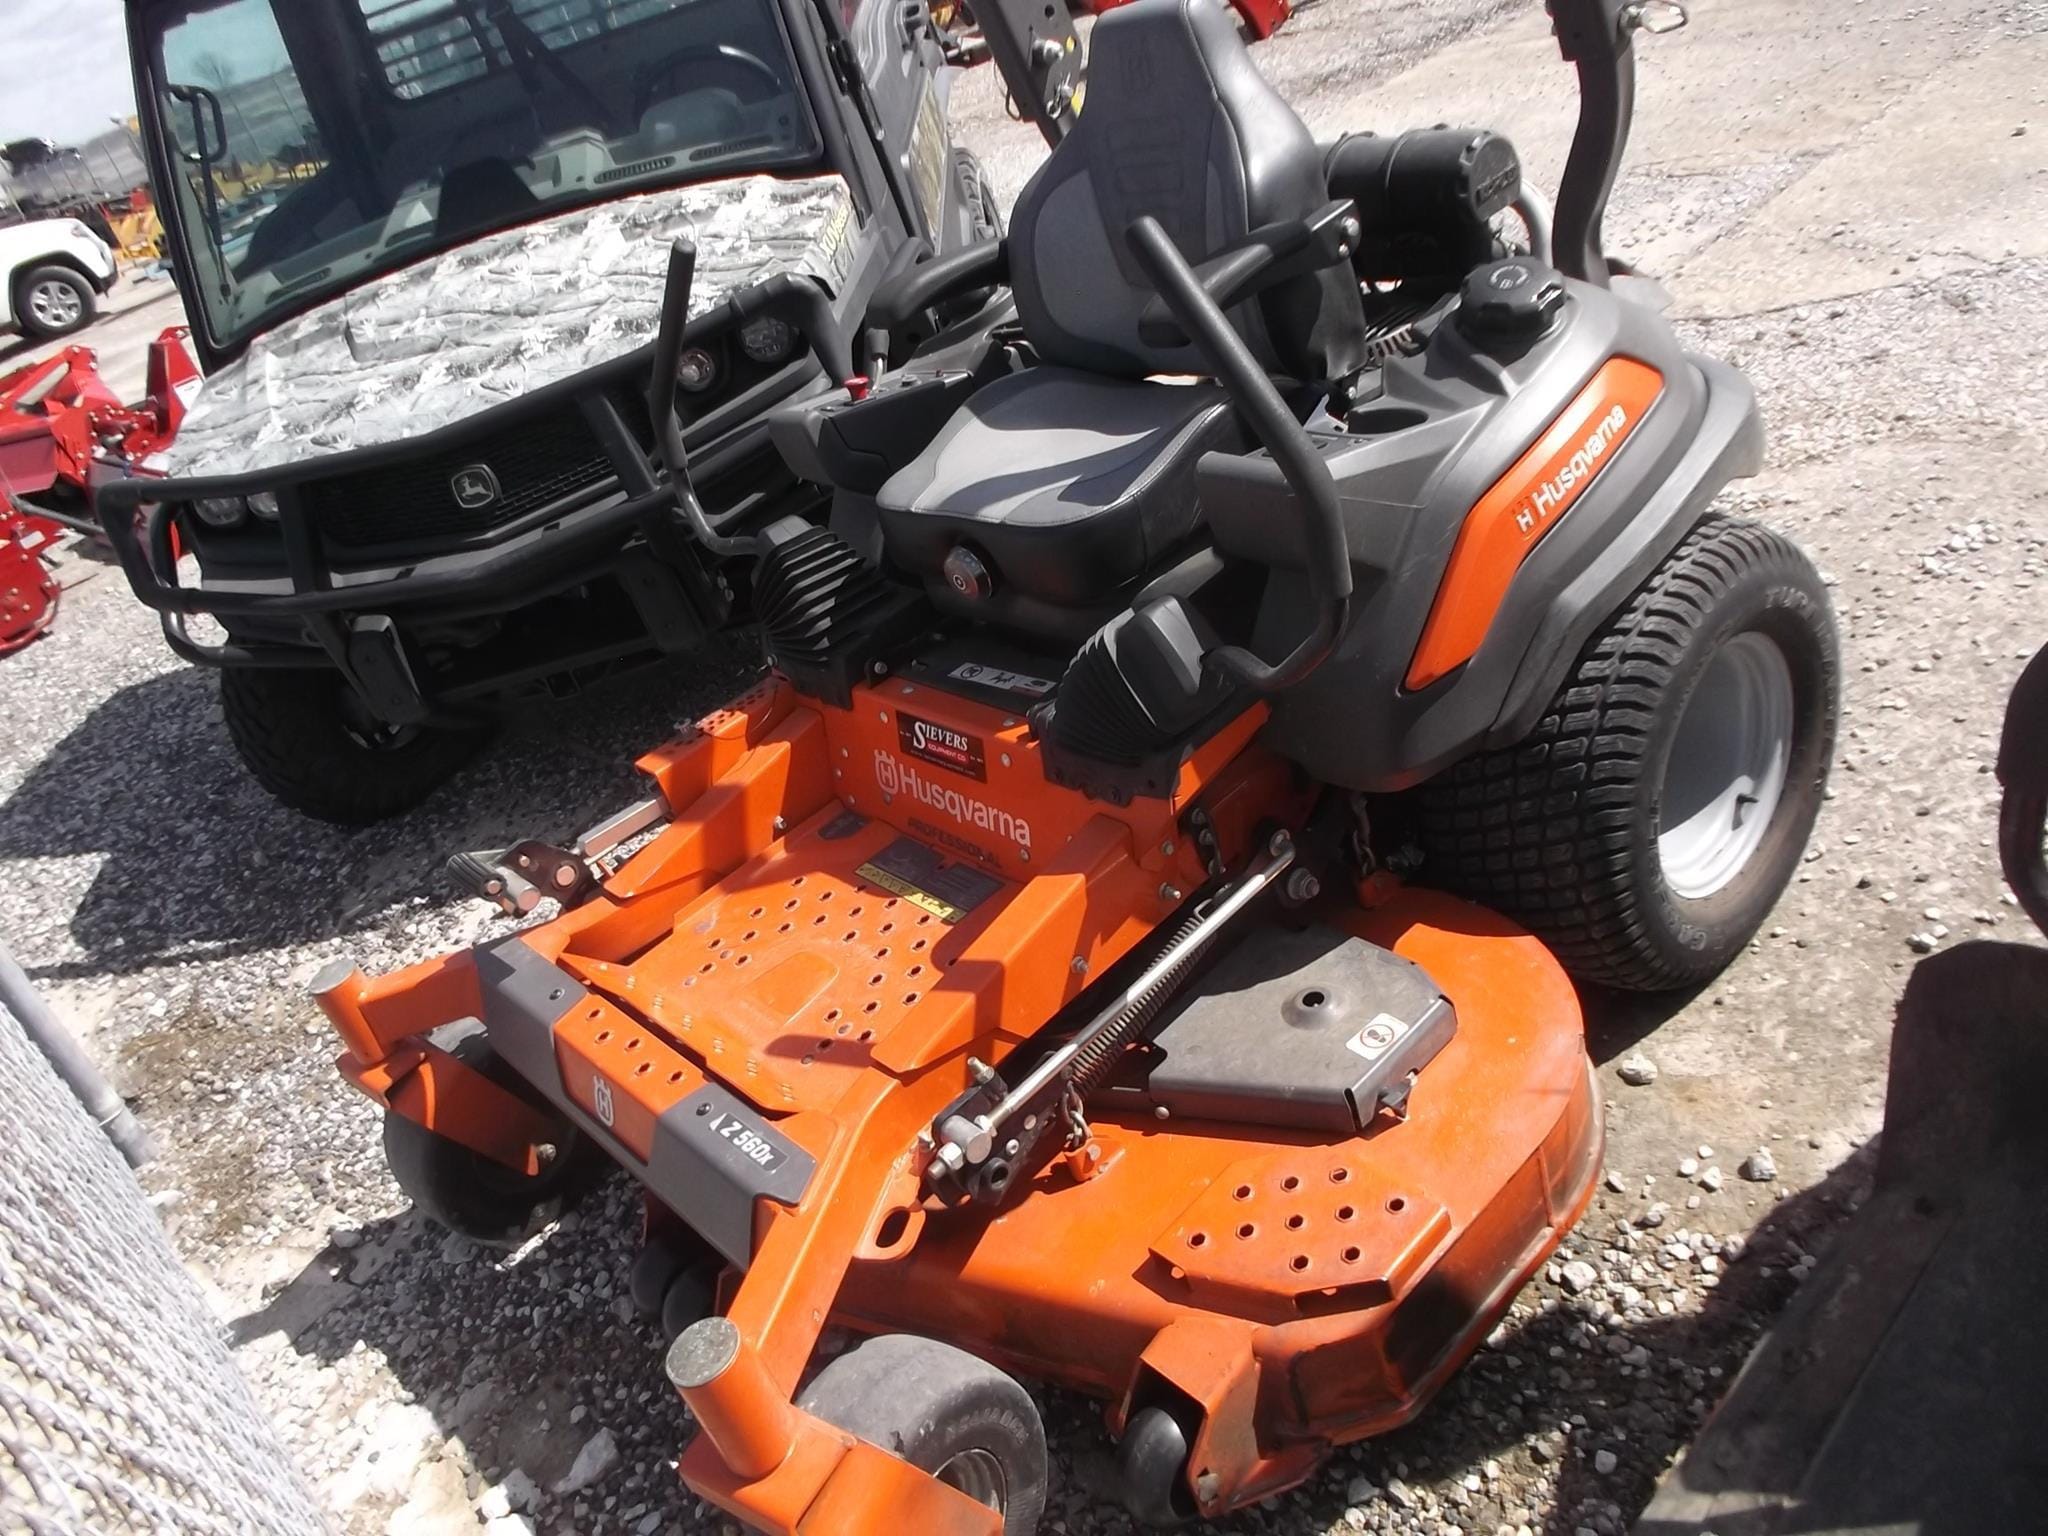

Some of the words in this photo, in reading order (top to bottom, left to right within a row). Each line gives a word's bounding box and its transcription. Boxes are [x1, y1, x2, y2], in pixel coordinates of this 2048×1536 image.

[1531, 404, 1627, 517] Husqvarna
[912, 721, 968, 752] SIEVERS
[900, 763, 1031, 847] Husqvarna
